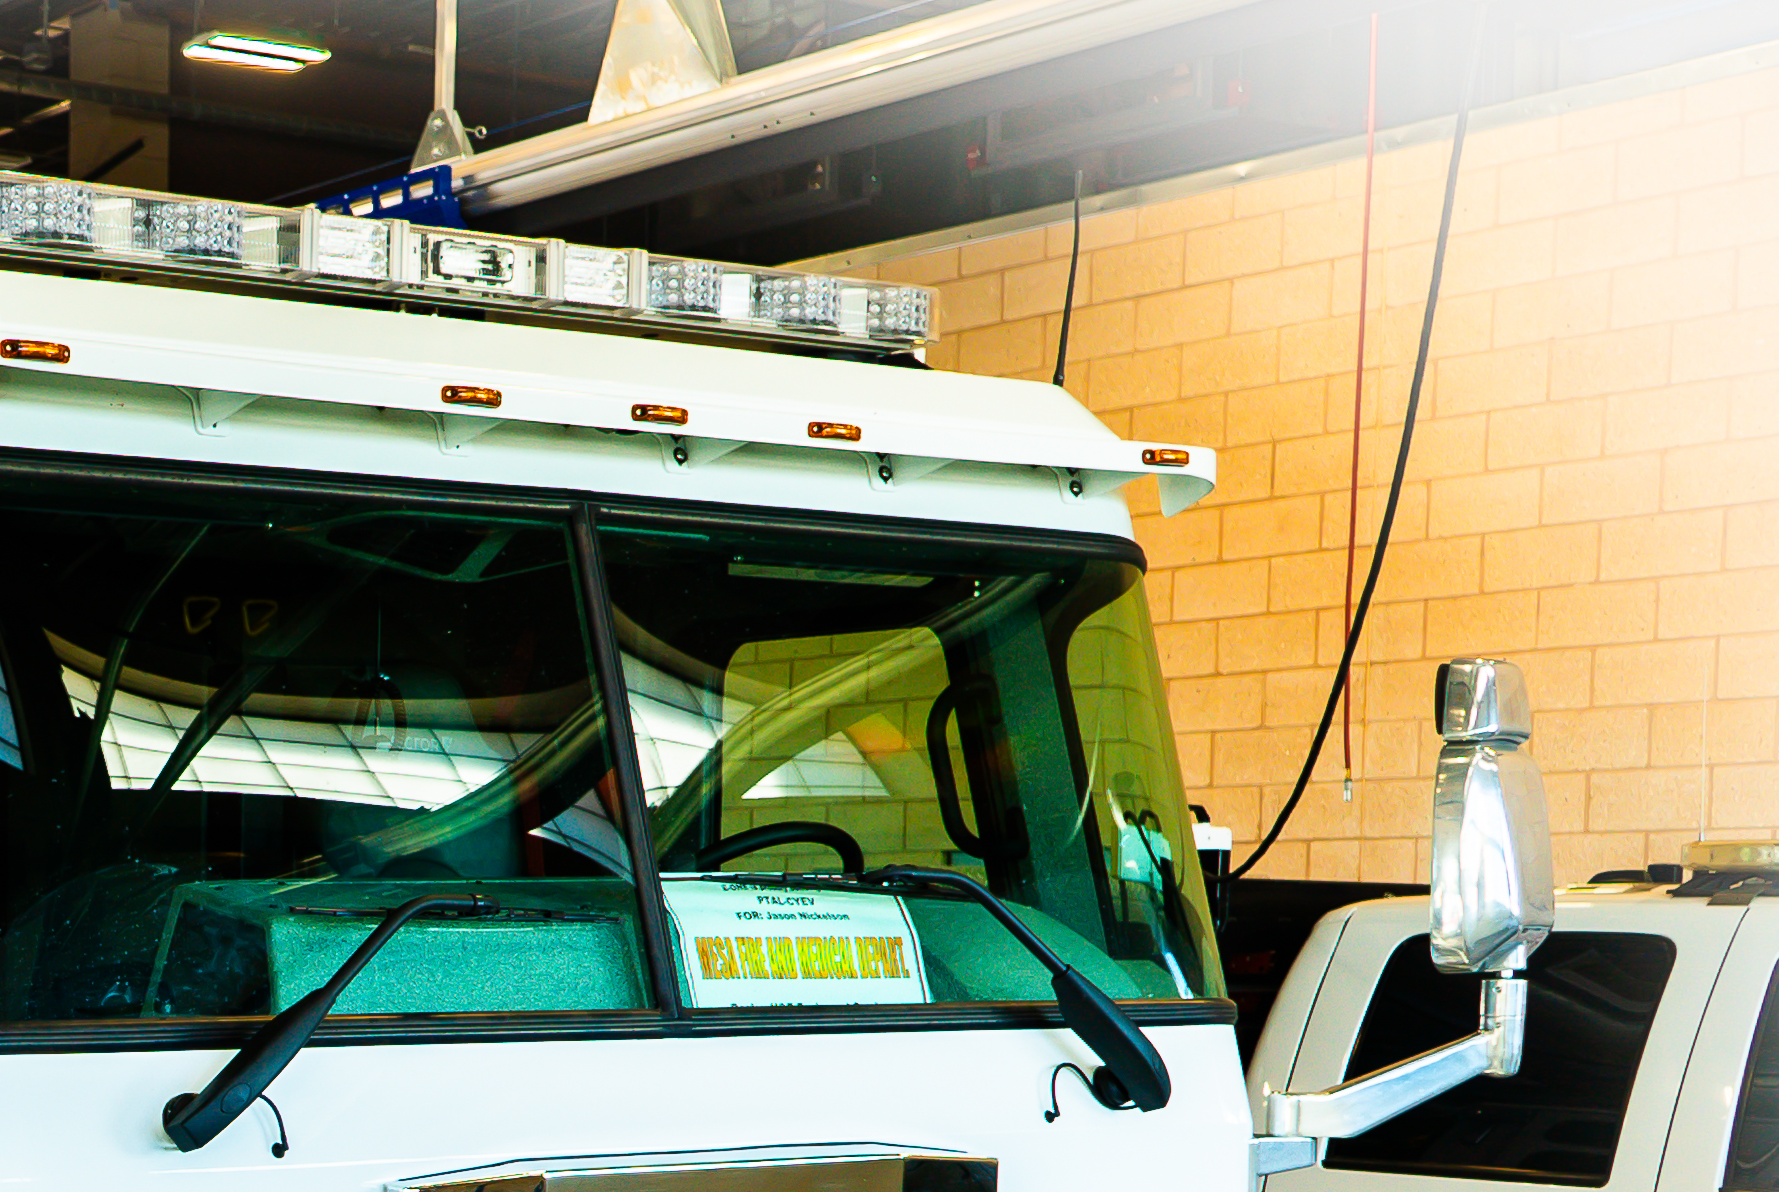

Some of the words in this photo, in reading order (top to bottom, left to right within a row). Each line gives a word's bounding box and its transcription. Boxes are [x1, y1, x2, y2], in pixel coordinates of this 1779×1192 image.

[735, 911, 764, 921] FOR:
[766, 911, 797, 921] Jason
[694, 936, 741, 980] MESA
[734, 936, 771, 980] FIRE
[765, 936, 799, 980] AND
[795, 936, 859, 980] MEDICAL
